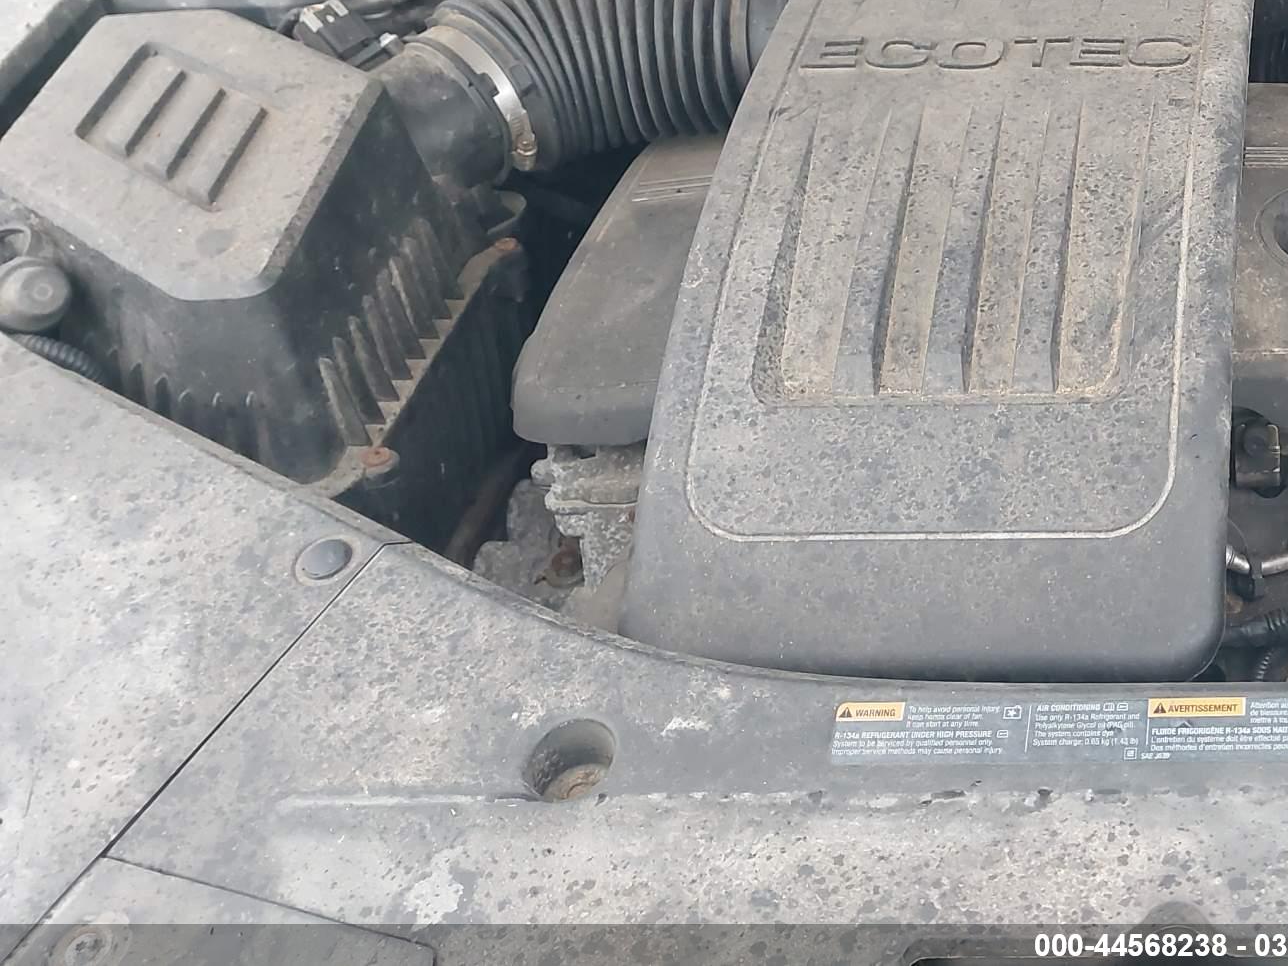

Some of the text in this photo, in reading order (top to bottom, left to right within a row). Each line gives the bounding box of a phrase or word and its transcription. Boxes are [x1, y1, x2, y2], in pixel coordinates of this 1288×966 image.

[800, 36, 1194, 69] ECOTEC
[1037, 704, 1049, 712] AIR
[1167, 704, 1238, 713] AVERTISSEMENT
[855, 708, 897, 718] WARNING
[861, 731, 910, 739] REFRIGERANT
[911, 731, 935, 739] UNDER
[936, 730, 953, 738] HIGH
[955, 730, 992, 738] PRESSURE
[1151, 727, 1177, 735] FLUIDE
